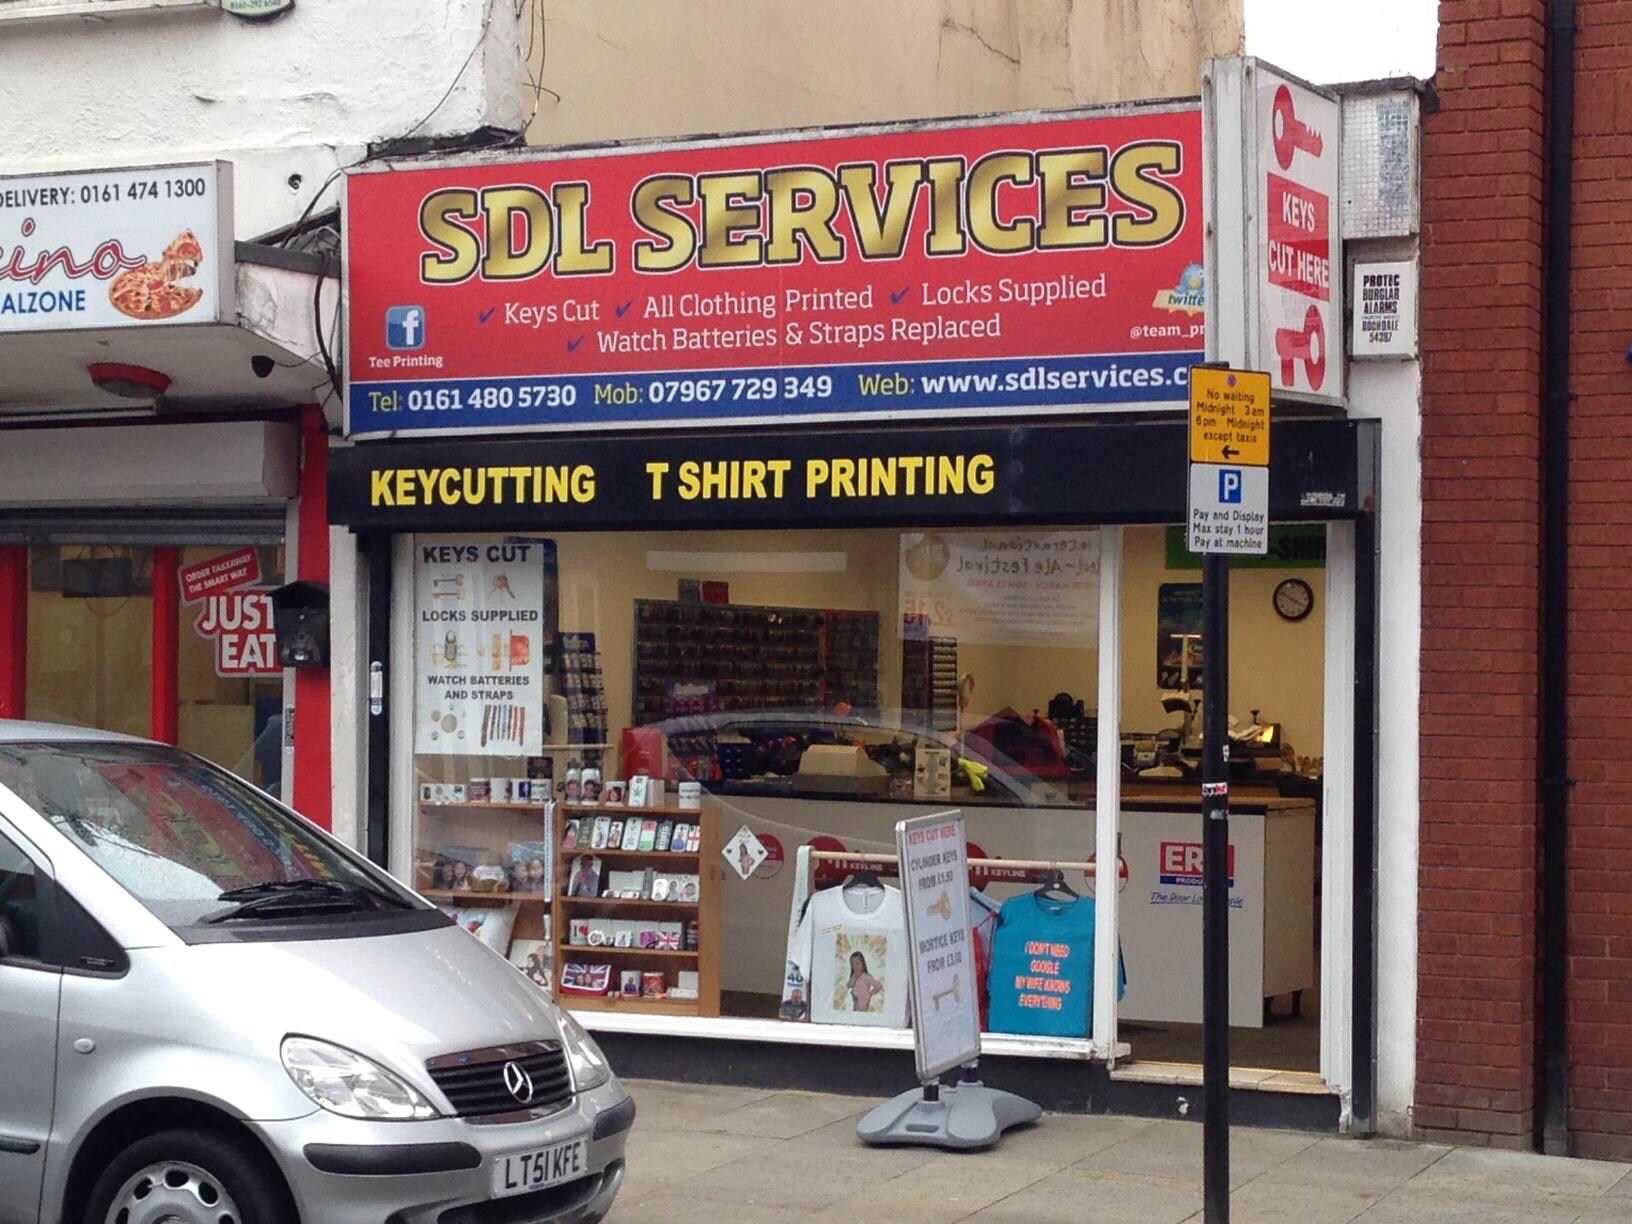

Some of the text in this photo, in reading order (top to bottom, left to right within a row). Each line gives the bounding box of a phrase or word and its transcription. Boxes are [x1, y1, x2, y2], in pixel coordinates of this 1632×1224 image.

[80, 184, 120, 203] 0161
[127, 181, 158, 200] 474
[165, 178, 206, 198] 1300
[419, 140, 1187, 285] SDL SERVICES
[1282, 191, 1316, 233] KEYS
[0, 217, 148, 285] ino
[1268, 239, 1329, 287] CUT HERE
[1363, 274, 1400, 287] PROTEC
[0, 289, 86, 314] ALZONE
[504, 274, 1107, 329] Keys Cut All Clothing Printed Locks Supplied
[1168, 292, 1205, 306] twitte
[1363, 301, 1398, 314] ALARMS
[597, 313, 1000, 354] Watch Batteries & Straps Replaced
[1130, 324, 1205, 338] @team_pr
[369, 354, 443, 369] Tee Printing
[369, 364, 1188, 412] Tel: 0161 480 5730 Mob: 07967 729 349 Web: www.sdlservices.c
[1207, 389, 1255, 404] No waiting
[1196, 401, 1235, 415] Midnight
[1226, 418, 1265, 431] Midnight
[1203, 432, 1257, 444] except taxis
[370, 453, 995, 506] KEYCUTTING T SHIRT PRINTING
[1224, 473, 1239, 500] P
[1193, 508, 1265, 523] Pay and Display
[1193, 522, 1211, 533] Max
[1215, 524, 1233, 536] stay
[1244, 524, 1264, 535] hour
[1194, 536, 1262, 549] Pay at machine
[423, 545, 531, 563] KEYS CUT
[185, 554, 251, 583] ORDER TAKEAWAY
[189, 567, 248, 594] THE SMART WAY
[202, 594, 274, 630] JUST
[422, 609, 538, 622] LOCKS SUPPLIED
[222, 633, 276, 669] EAT
[427, 675, 529, 686] WATCH BATTERIES
[445, 690, 514, 700] AND STRAPS
[908, 824, 957, 846] KEYS CUT HERE
[911, 850, 958, 872] CYLINDER KEYS
[1165, 846, 1204, 872] ER
[918, 874, 936, 890] FROM
[990, 868, 1027, 878] KEYLINE
[1151, 892, 1167, 901] The
[919, 928, 965, 955] MORTICE KEYS
[927, 957, 946, 974] FROM
[1030, 959, 1061, 975] GOOGLE
[552, 1142, 581, 1179] KFE
